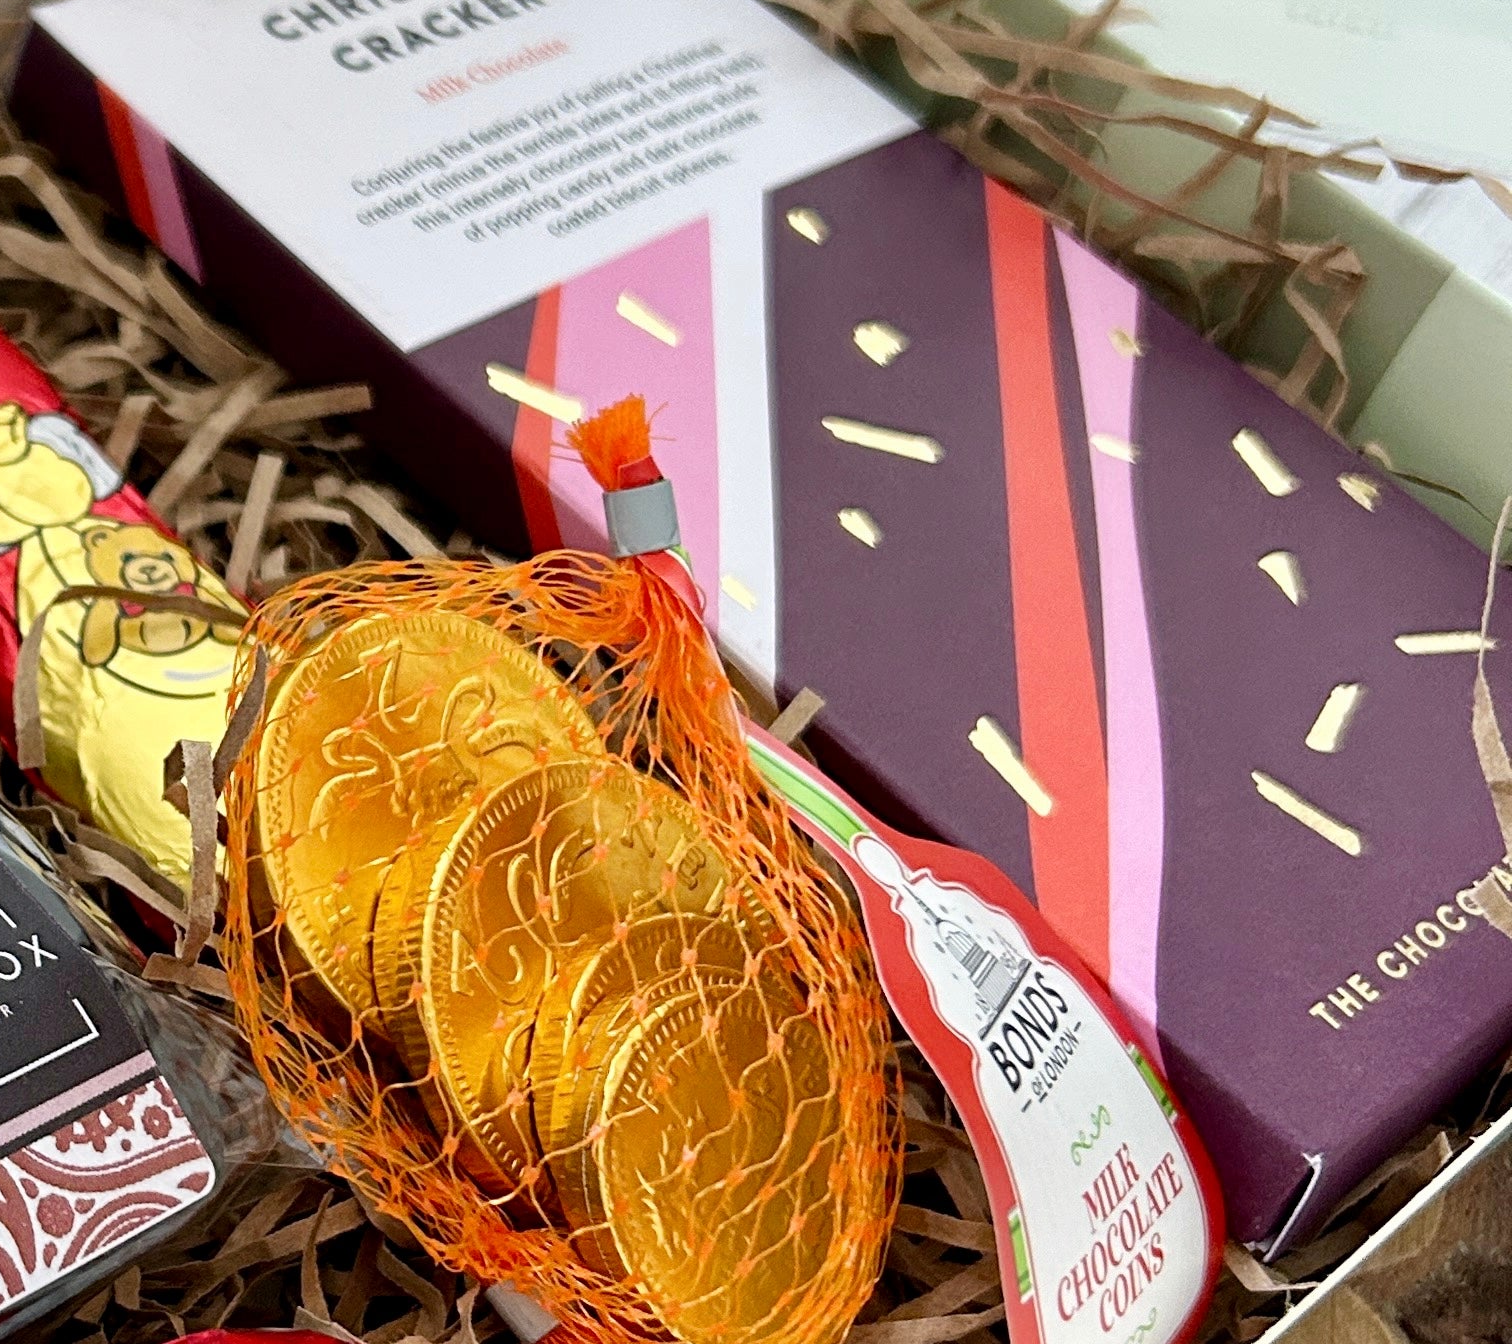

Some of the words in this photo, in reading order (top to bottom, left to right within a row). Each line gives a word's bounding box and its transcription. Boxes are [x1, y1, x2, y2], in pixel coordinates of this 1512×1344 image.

[417, 75, 471, 105] Milk
[466, 38, 569, 84] Chocolate
[351, 154, 445, 196] Conjuring
[439, 138, 474, 159] the
[469, 116, 529, 146] festive
[556, 92, 577, 113] of
[356, 189, 423, 227] cracker
[484, 150, 518, 171] the
[621, 92, 655, 116] and
[411, 208, 451, 233] this
[449, 175, 531, 218] intensely
[463, 222, 486, 244] of
[485, 194, 562, 237] popping
[558, 168, 613, 202] candy
[610, 151, 647, 177] and
[547, 199, 607, 237] coated
[1309, 972, 1380, 1030] THE
[1376, 858, 1512, 979] CHOCOA
[987, 970, 1068, 1094] BONDS
[1039, 1026, 1080, 1090] LONDON
[1057, 1151, 1184, 1322] CHOCOLATE
[1082, 1141, 1140, 1236] MILK
[1099, 1232, 1164, 1333] COINS
